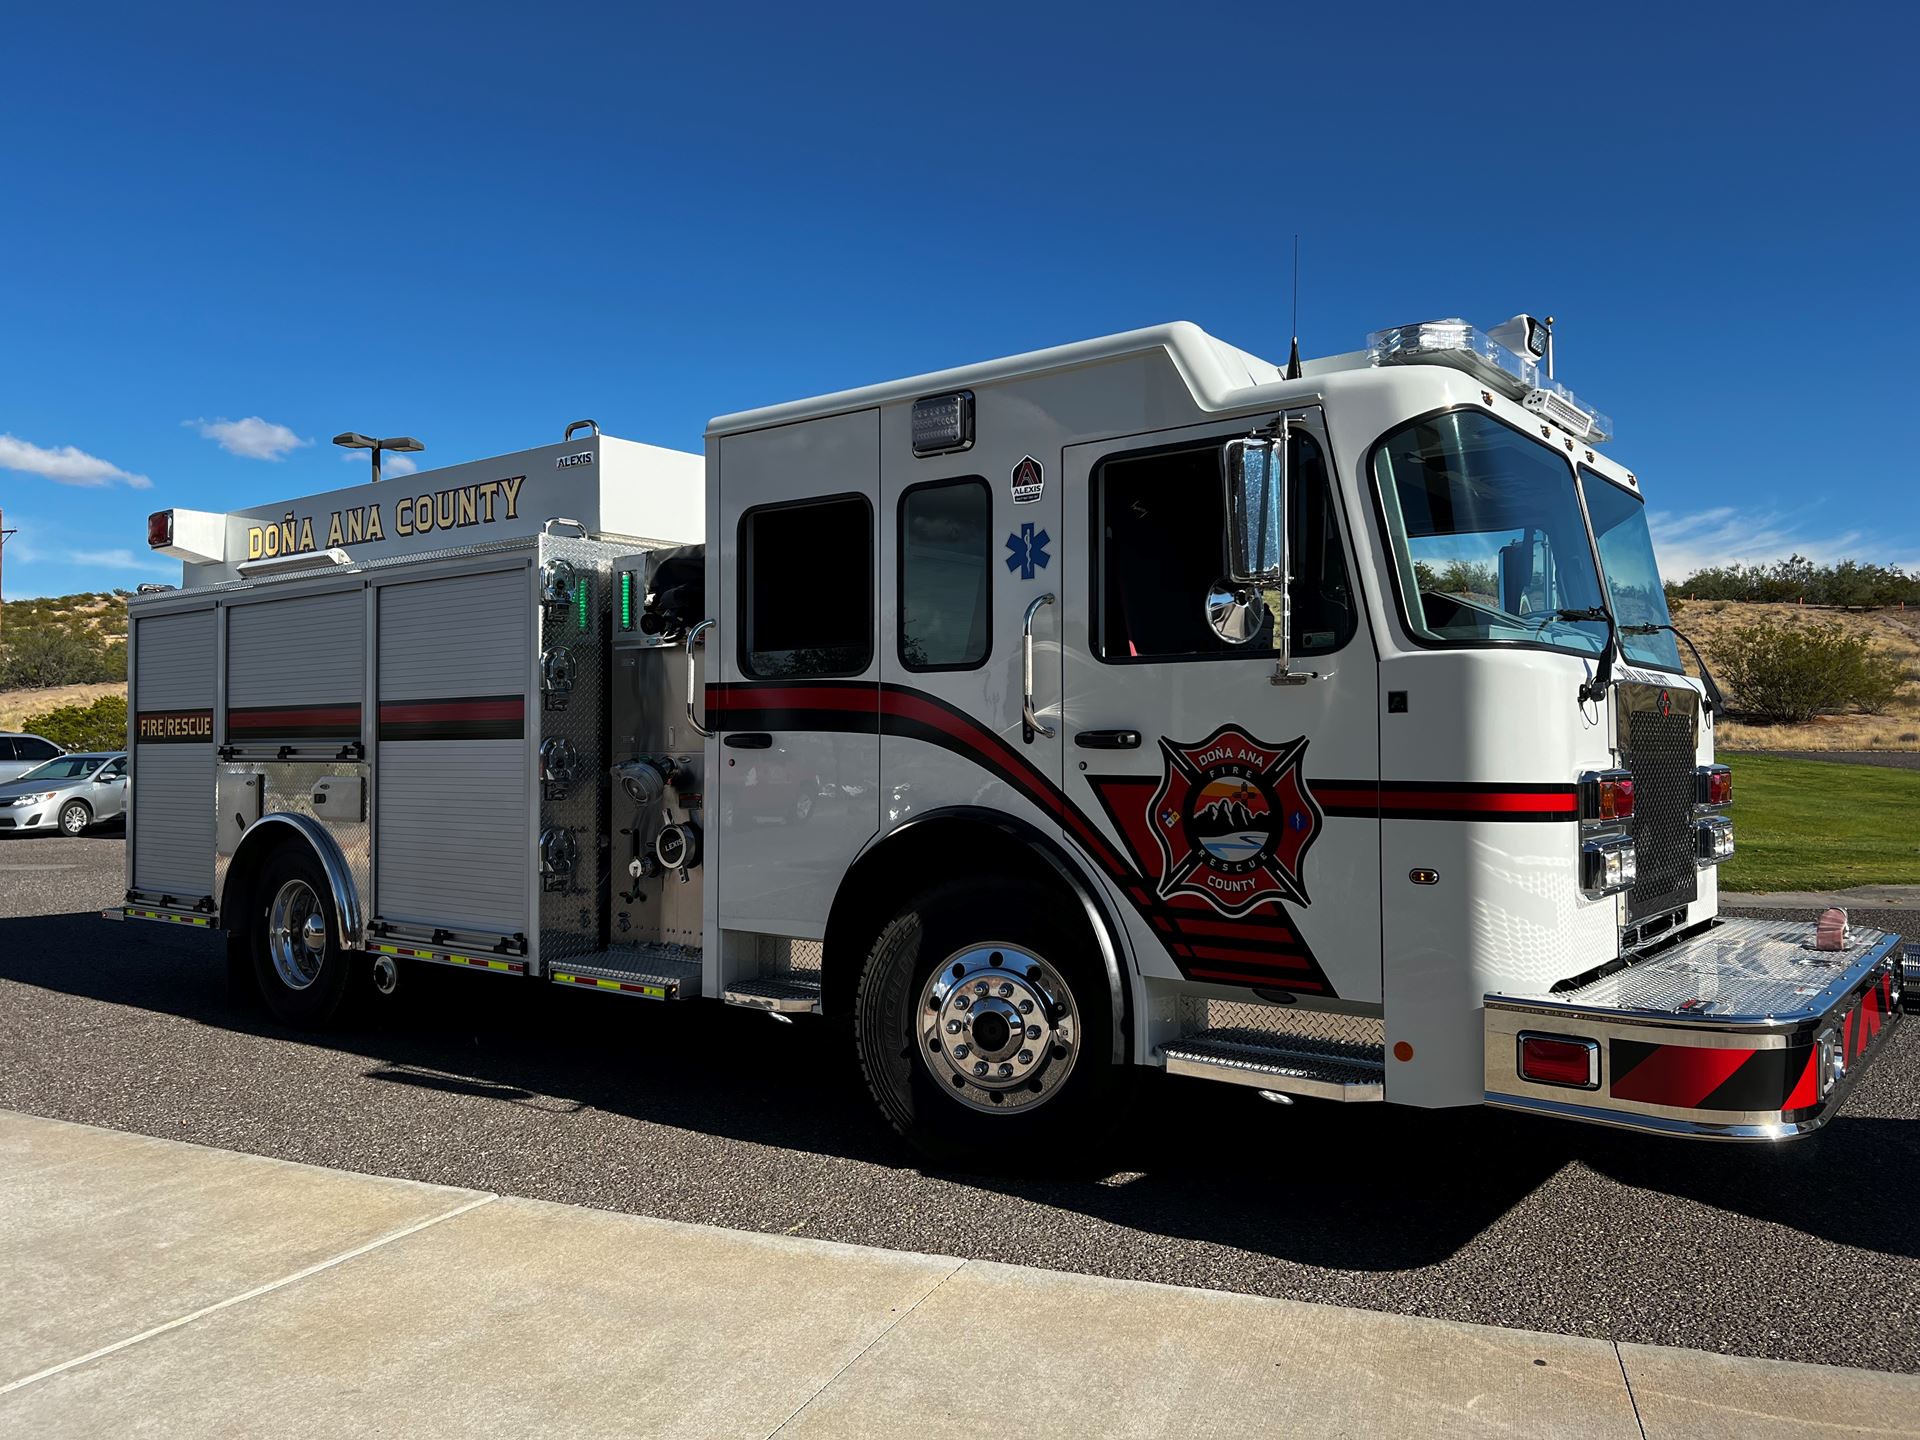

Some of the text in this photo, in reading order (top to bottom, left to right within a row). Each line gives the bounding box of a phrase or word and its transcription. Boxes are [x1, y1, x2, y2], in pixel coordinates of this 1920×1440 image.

[558, 453, 592, 468] ALEXIS
[1014, 485, 1041, 495] ALEXIS
[248, 475, 527, 560] DOÑA ANA COUNTY
[141, 716, 211, 739] FIRE/RESCUE
[1198, 746, 1264, 767] DOÑA ANA
[1209, 766, 1253, 779] FIRE
[1198, 849, 1268, 872] RESCUE
[1207, 875, 1256, 892] COUNTY
